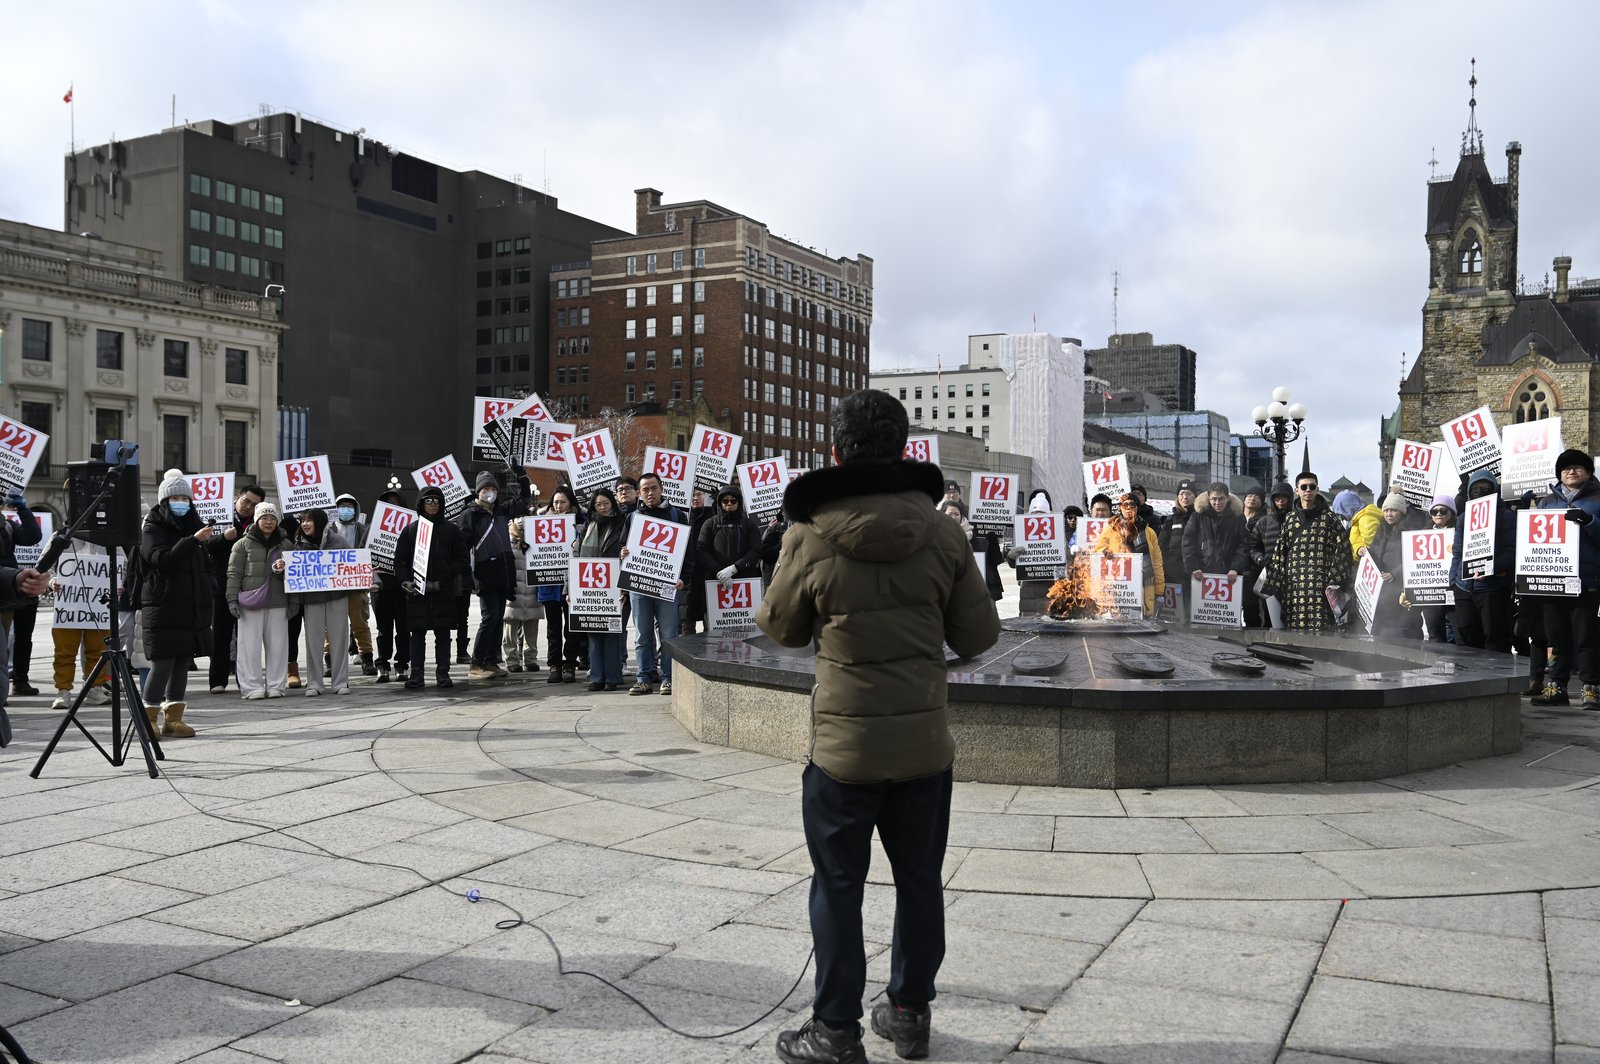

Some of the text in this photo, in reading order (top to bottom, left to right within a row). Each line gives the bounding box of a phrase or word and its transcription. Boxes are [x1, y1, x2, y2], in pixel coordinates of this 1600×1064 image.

[0, 425, 32, 456] 22
[1456, 417, 1482, 445] 19
[577, 436, 602, 462] 31
[704, 433, 728, 457] 13
[904, 441, 927, 462] 38
[1460, 444, 1496, 463] WAITING FOR
[1463, 440, 1487, 453] MONTHS
[582, 460, 604, 471] MONTHS
[656, 453, 682, 479] 39
[700, 455, 723, 466] MONTHS
[1405, 446, 1428, 469] 30
[1459, 462, 1472, 471] IRCC
[1472, 449, 1502, 466] RESPONSE
[1510, 463, 1536, 471] WAITING
[11, 464, 24, 474] FOR
[290, 461, 317, 486] 39
[426, 464, 449, 487] 39
[577, 469, 600, 479] WAITING
[588, 470, 617, 482] RESPONSE
[700, 469, 728, 481] RESPONSE
[752, 464, 778, 487] 22
[1095, 462, 1115, 484] 27
[1403, 470, 1424, 478] MONTHS
[1520, 468, 1554, 478] RESPONSE
[194, 477, 220, 500] 39
[984, 478, 1005, 500] 72
[1397, 475, 1418, 484] WAITING
[1404, 483, 1431, 493] RESPONSE
[288, 494, 314, 503] WAITING
[293, 487, 319, 495] MONTHS
[752, 494, 775, 503] WAITING
[756, 487, 780, 496] MONTHS
[300, 498, 332, 508] RESPONSE
[384, 509, 408, 534] 40
[1472, 501, 1488, 530] 30
[538, 520, 562, 543] 35
[643, 522, 674, 552] 22
[1028, 518, 1052, 540] 23
[1471, 532, 1486, 540] MONTHS
[1533, 515, 1561, 543] 31
[369, 544, 381, 552] IRCC
[373, 538, 395, 549] WAITING
[1416, 534, 1441, 560] 30
[292, 550, 357, 564] STOP THE
[632, 556, 674, 571] WAITING FOR
[640, 550, 668, 562] MONTHS
[59, 558, 123, 578] CANAA
[582, 563, 607, 588] 43
[626, 562, 676, 580] IRCC RESPONSE
[1105, 557, 1127, 580] 11
[330, 576, 373, 588] TOGETHER
[1205, 578, 1229, 601] 25
[57, 584, 93, 603] WHAT
[722, 584, 749, 608] 34
[55, 608, 74, 623] YOU
